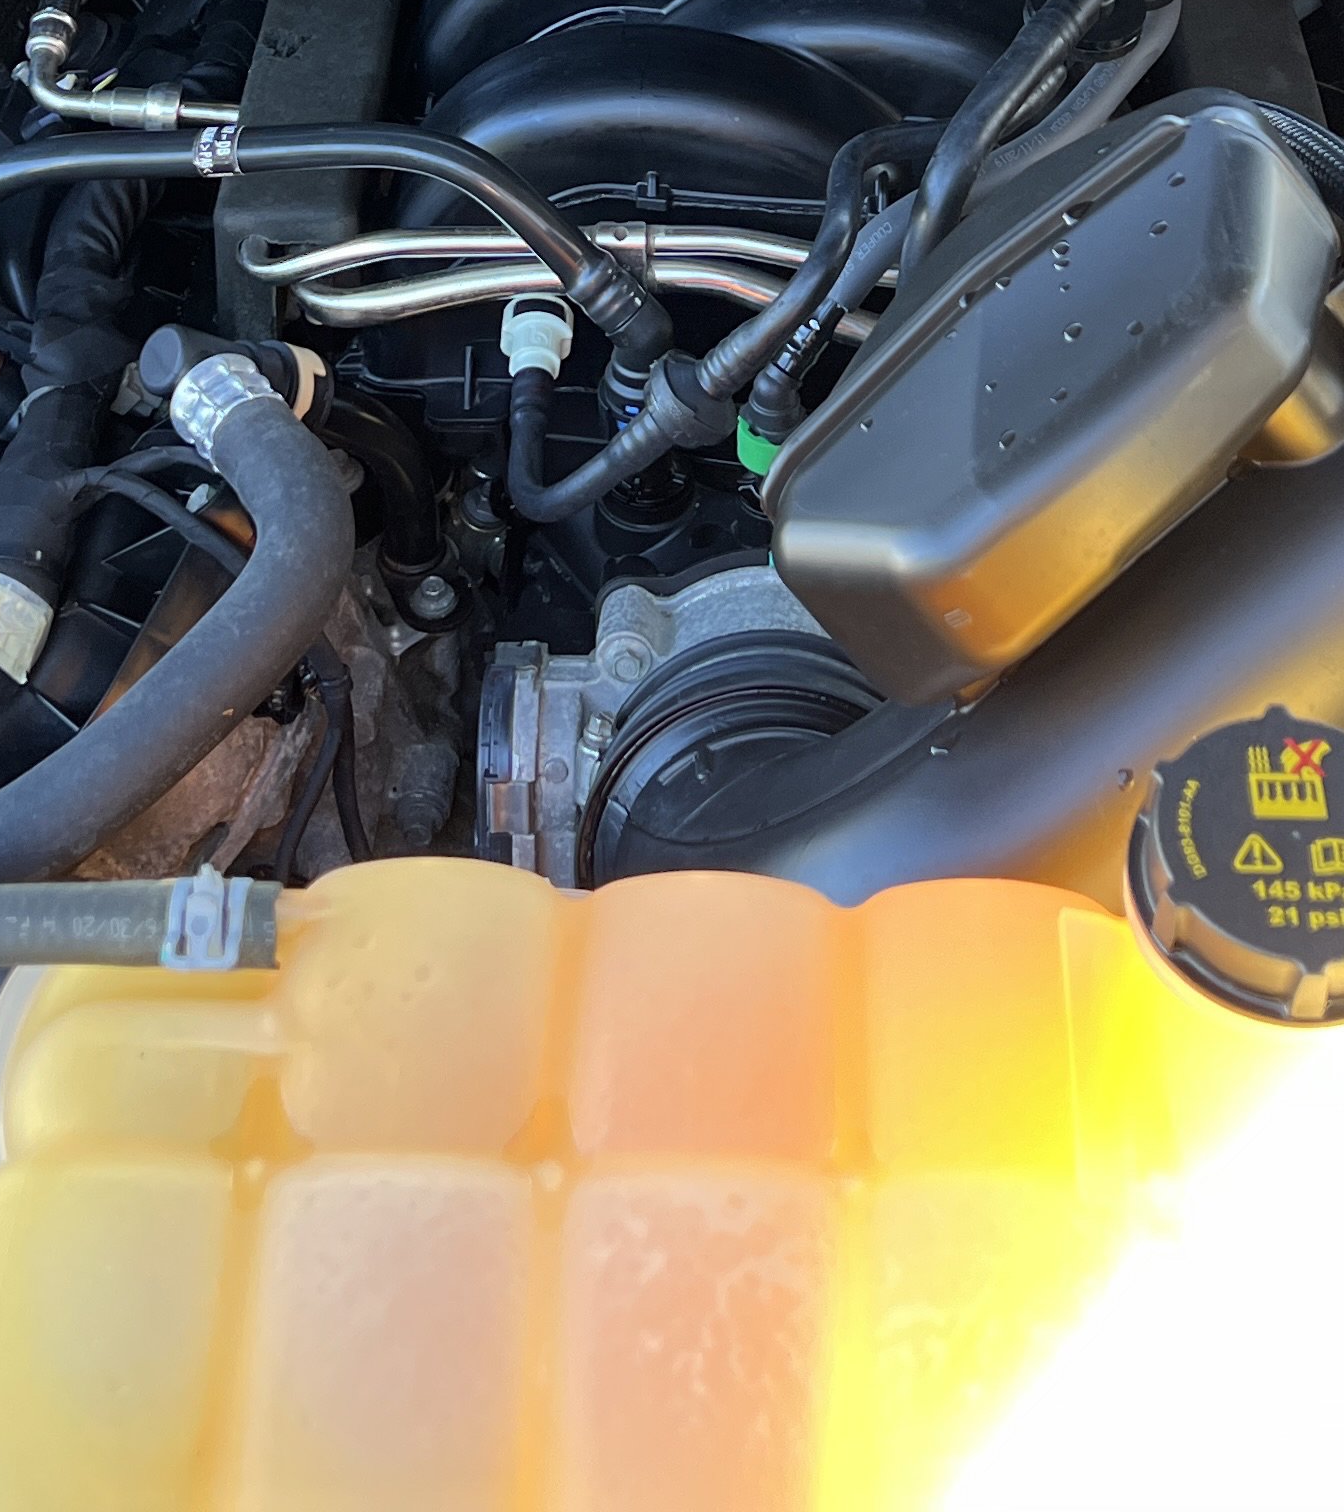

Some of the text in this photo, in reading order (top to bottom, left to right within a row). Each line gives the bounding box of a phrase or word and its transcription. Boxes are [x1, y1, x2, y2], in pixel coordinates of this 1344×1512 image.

[856, 221, 893, 261] COOPER
[1252, 879, 1302, 902] 145
[1268, 906, 1301, 927] 21
